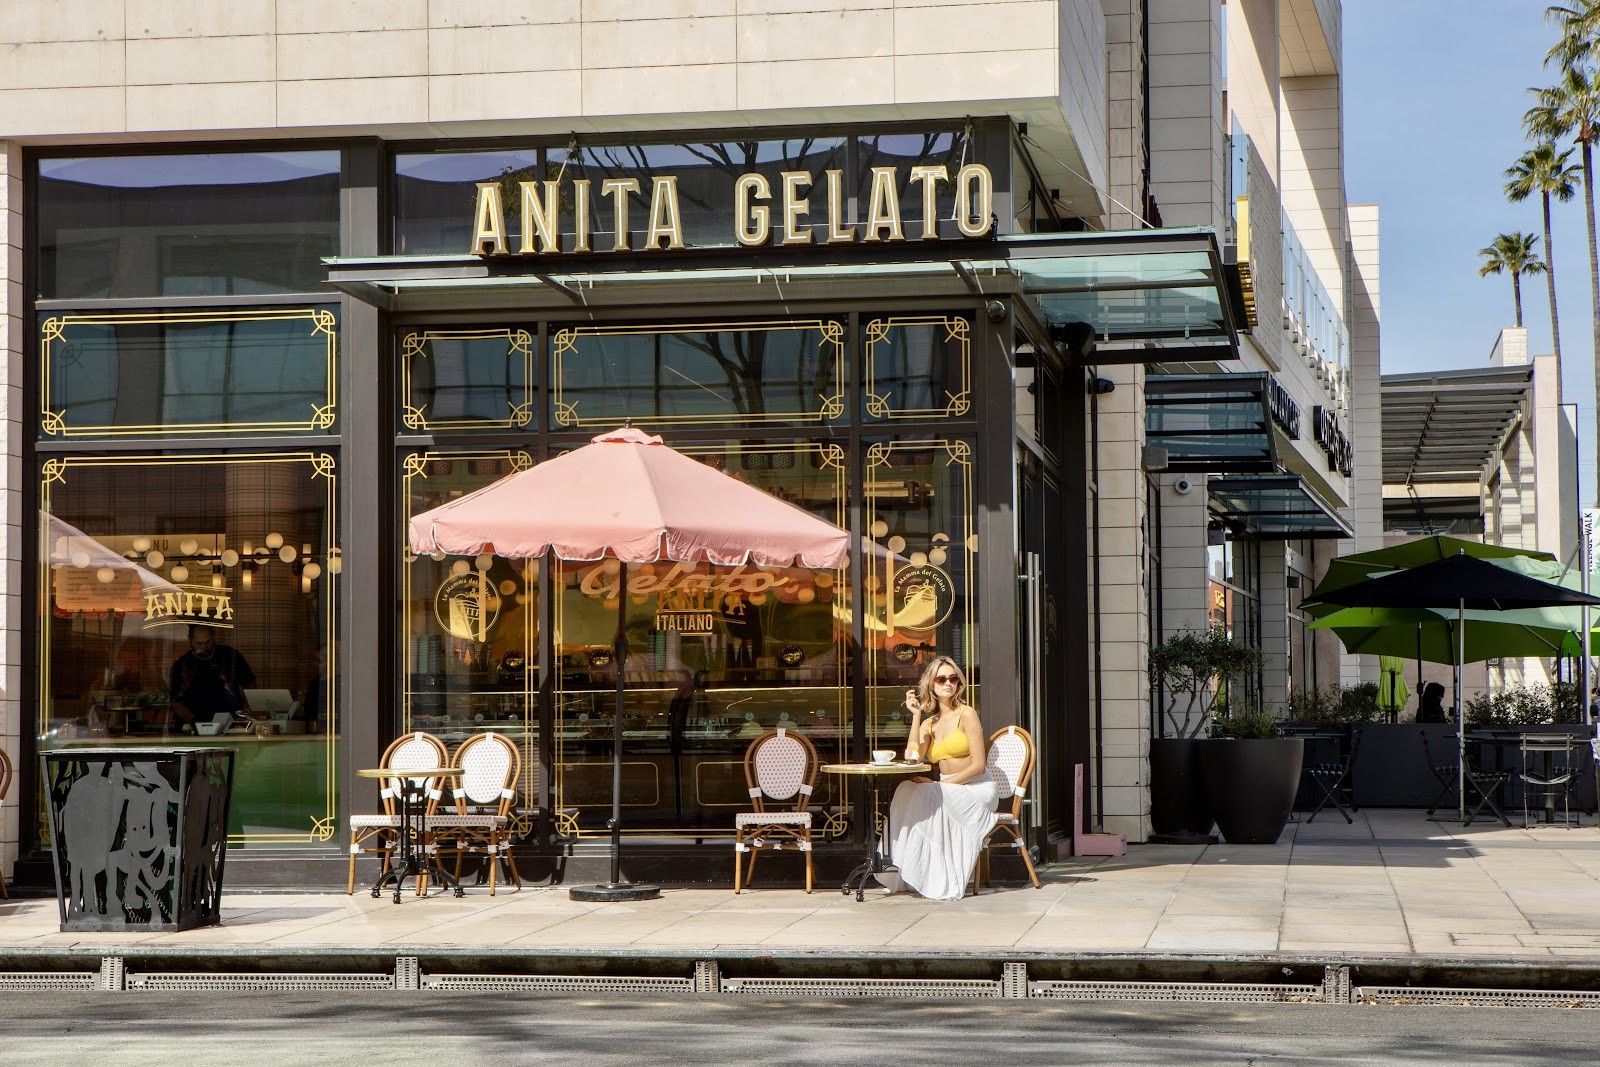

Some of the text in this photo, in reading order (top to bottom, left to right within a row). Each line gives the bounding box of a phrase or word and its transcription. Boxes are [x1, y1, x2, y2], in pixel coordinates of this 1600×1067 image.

[470, 163, 994, 255] ANITA GELATO
[1584, 512, 1592, 535] WALK
[580, 560, 790, 598] Gelato
[898, 570, 920, 585] Mamma
[932, 573, 946, 592] Gelato
[143, 591, 234, 621] ANITA
[656, 614, 713, 631] ITALIANO
